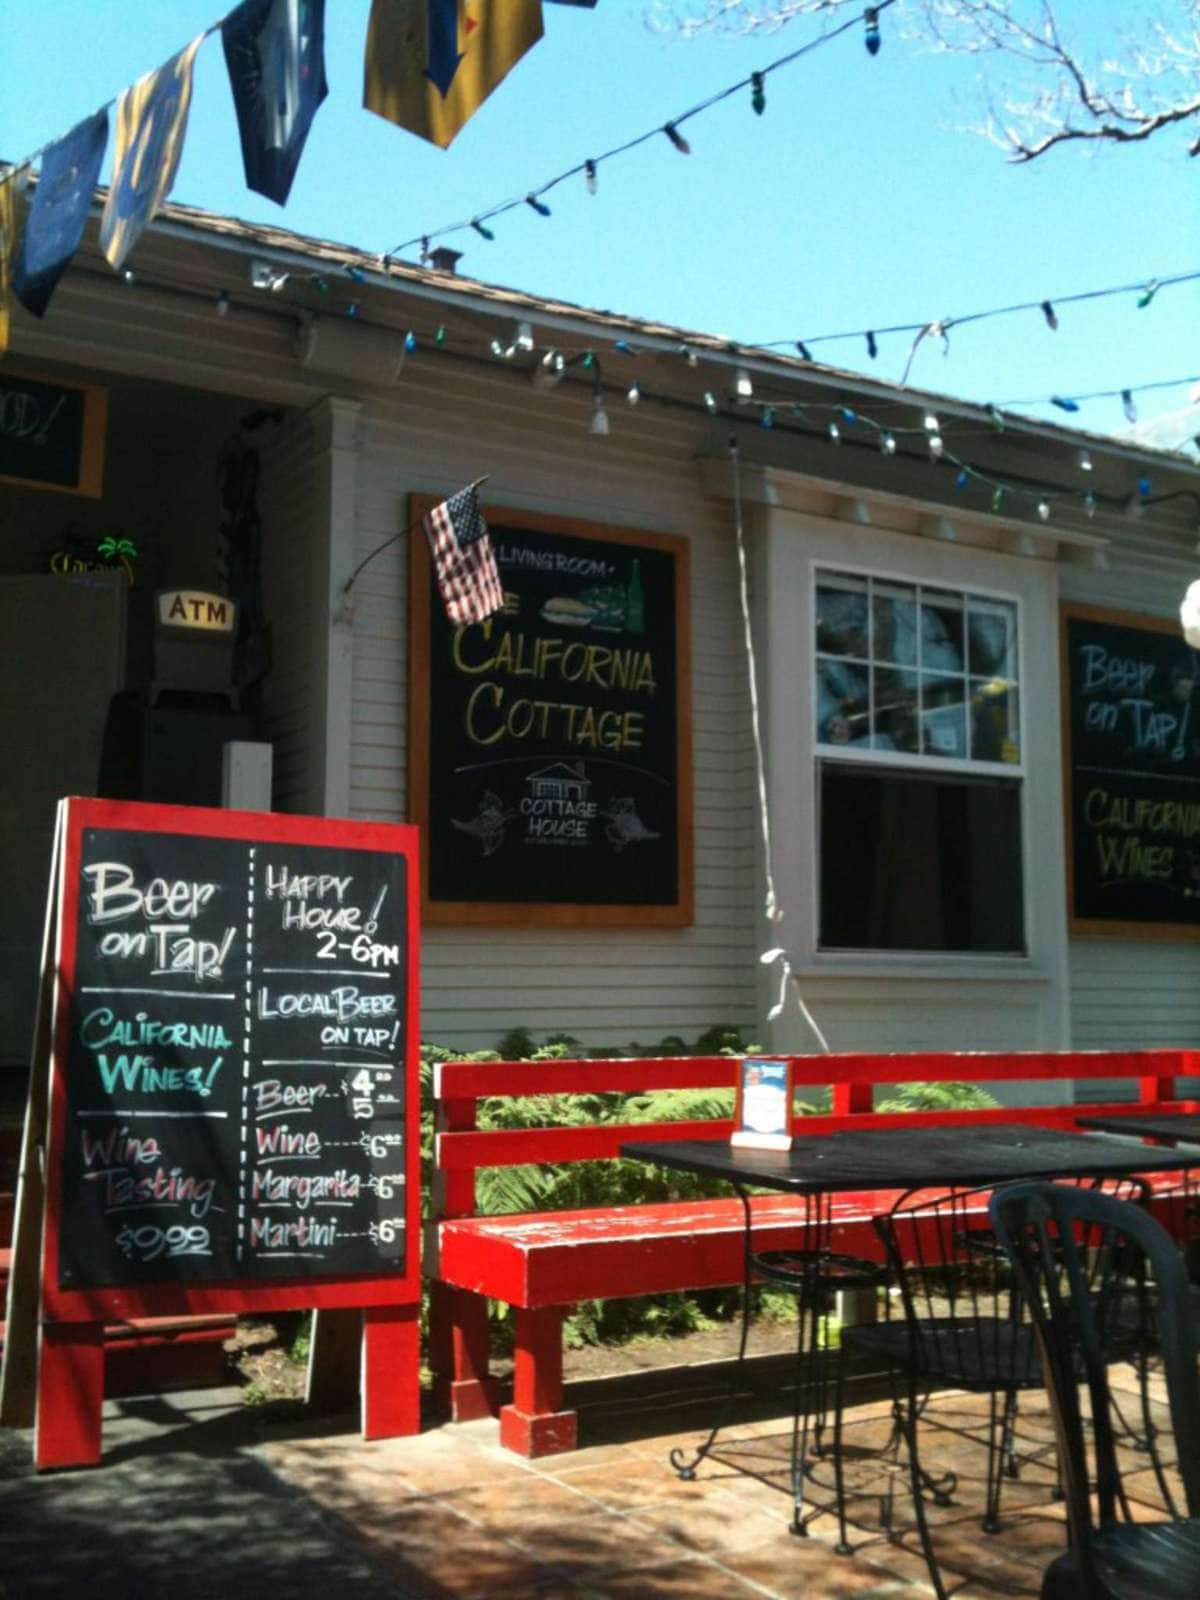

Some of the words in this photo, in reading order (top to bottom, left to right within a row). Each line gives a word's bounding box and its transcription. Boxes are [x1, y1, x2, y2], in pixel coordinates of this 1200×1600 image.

[168, 595, 227, 625] ATM
[453, 618, 657, 695] CALIFORNIA
[1080, 644, 1156, 692] Beer
[466, 681, 646, 752] COTTAGE
[520, 797, 598, 819] COTTAGE
[529, 815, 589, 838] HOUSE
[83, 862, 219, 925] Beer
[264, 865, 352, 900] HAPPY
[282, 884, 388, 935] HOUR!
[99, 931, 148, 958] on
[147, 924, 237, 982] Tap!
[80, 1007, 233, 1050] CALIFORNIA
[320, 1026, 350, 1045] ON
[97, 1054, 224, 1097] WINES!
[253, 1079, 327, 1111] Beer
[81, 1126, 162, 1167] Wine
[255, 1124, 323, 1156] Wine
[82, 1166, 217, 1218] Tasting
[251, 1168, 361, 1209] Margarita
[250, 1215, 338, 1248] Martini
